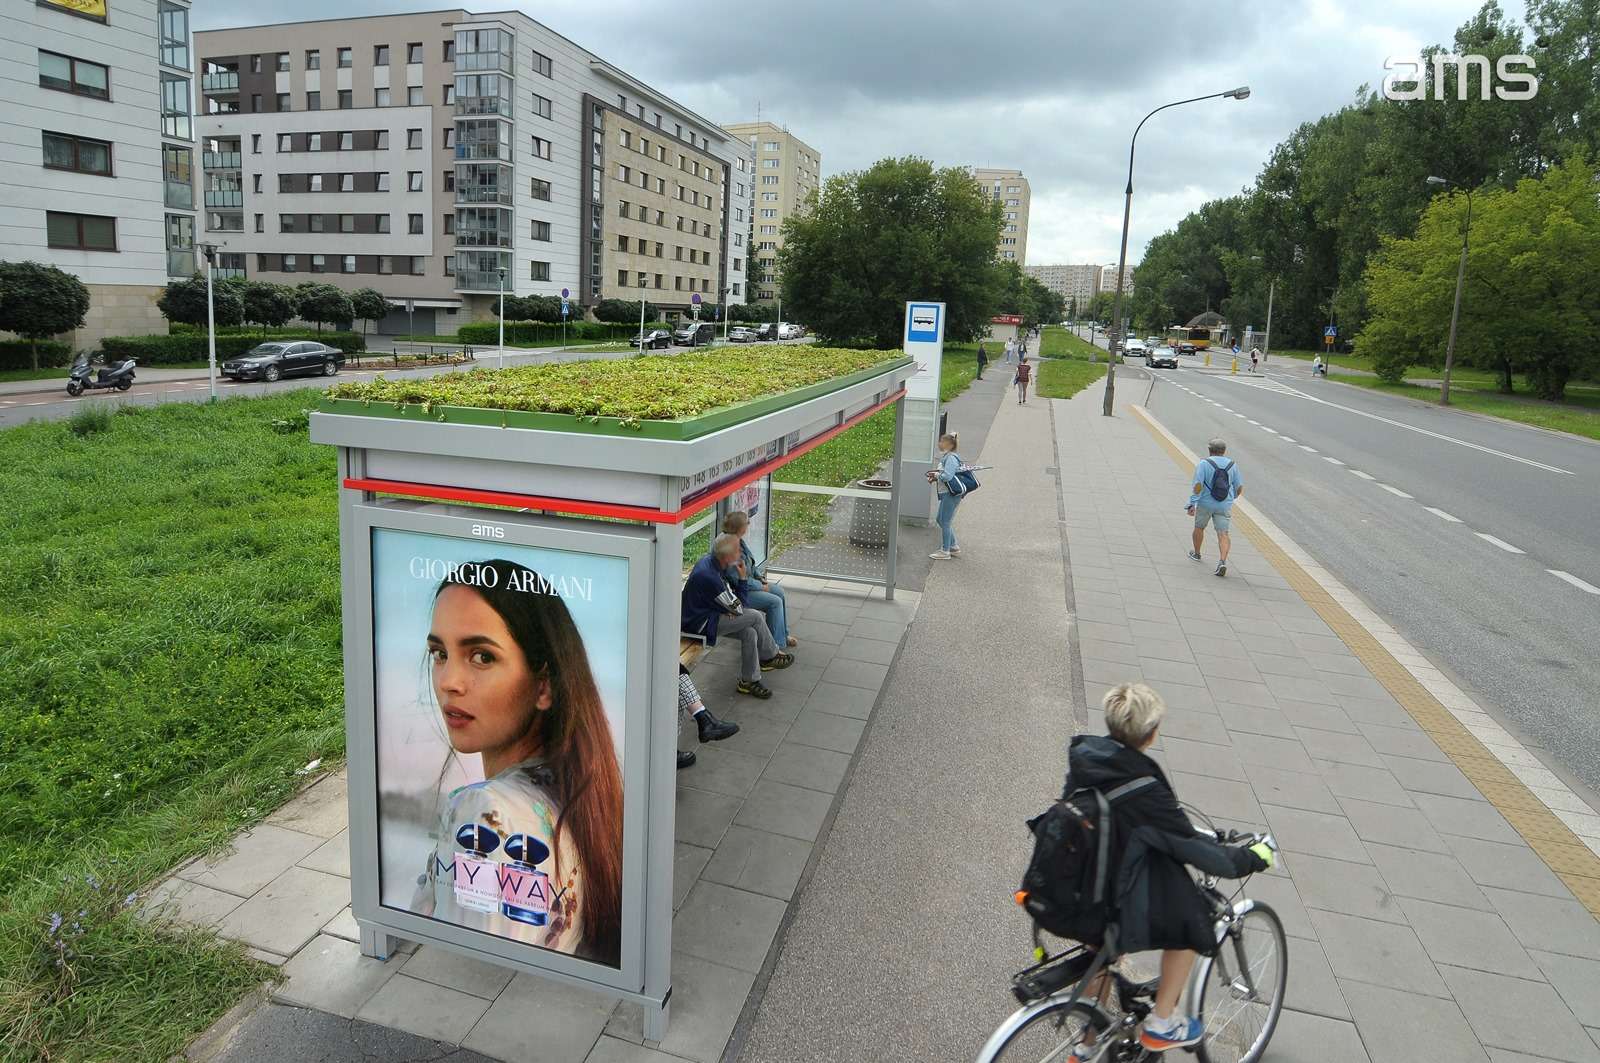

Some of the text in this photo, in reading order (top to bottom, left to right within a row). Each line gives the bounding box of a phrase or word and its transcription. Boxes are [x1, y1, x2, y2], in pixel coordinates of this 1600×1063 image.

[472, 524, 505, 539] ams
[409, 556, 593, 602] GIORGIO ARMANI
[436, 856, 567, 903] MY WAY
